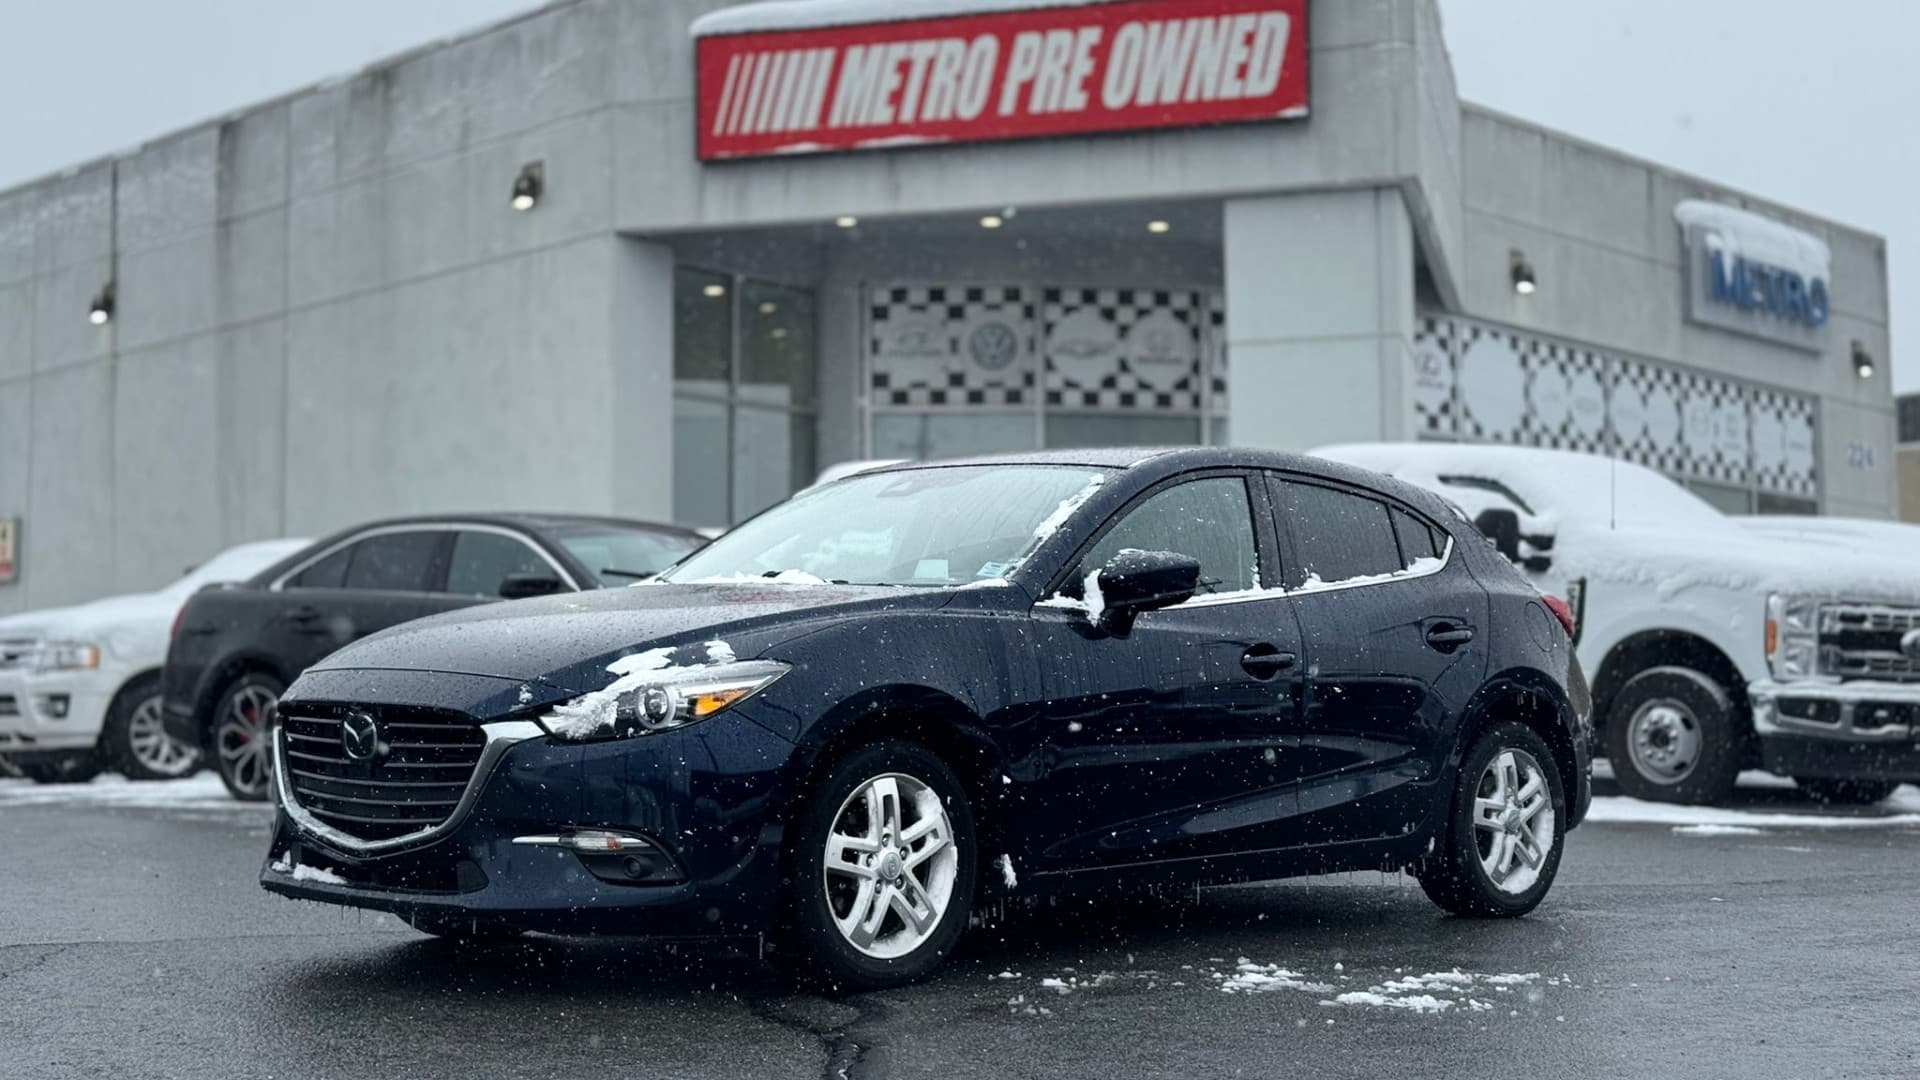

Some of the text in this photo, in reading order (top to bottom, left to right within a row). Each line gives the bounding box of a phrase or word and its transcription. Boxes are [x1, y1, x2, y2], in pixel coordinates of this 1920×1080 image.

[828, 11, 1292, 128] METRO PRE OWNED
[1711, 248, 1828, 327] METRO
